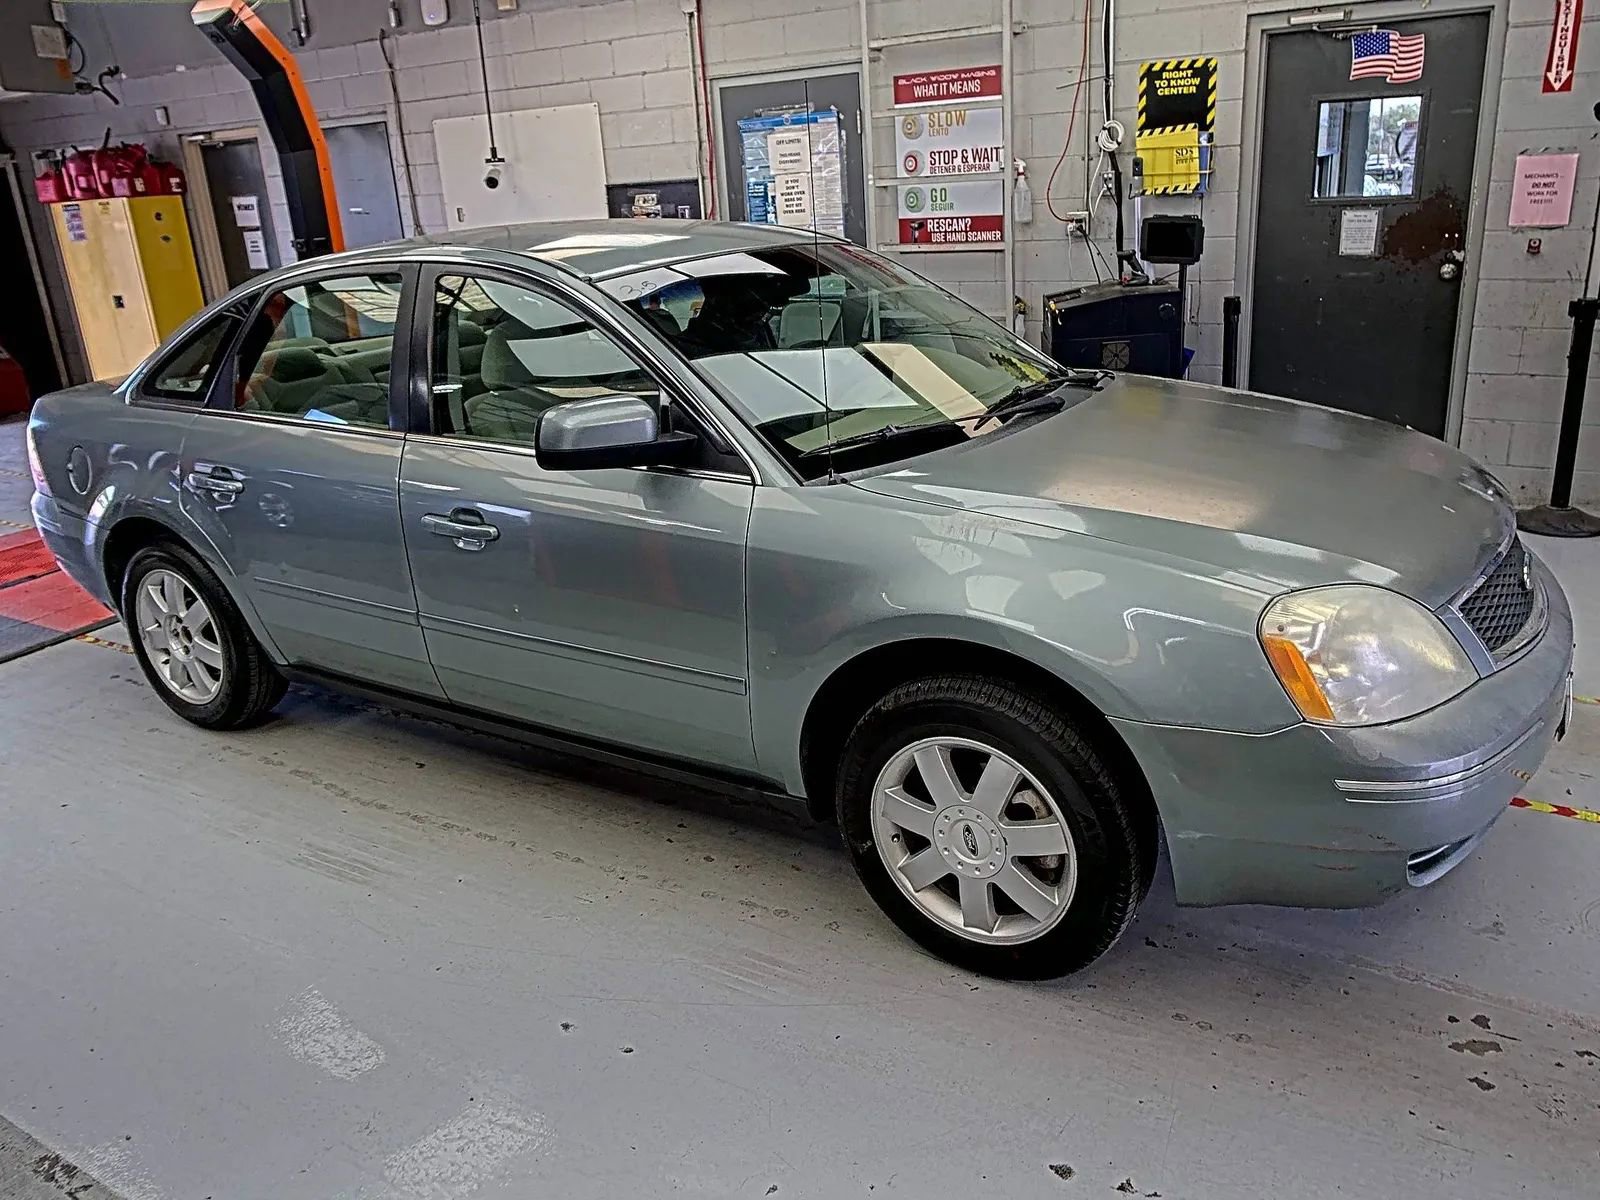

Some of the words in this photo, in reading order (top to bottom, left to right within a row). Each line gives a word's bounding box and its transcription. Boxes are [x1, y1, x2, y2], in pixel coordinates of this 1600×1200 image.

[1162, 70, 1193, 79] RIGHT
[1170, 78, 1200, 86] KNOW
[913, 83, 938, 97] WHAT
[939, 82, 947, 95] IT
[949, 79, 981, 94] MEANS
[1157, 86, 1196, 95] CENTER
[928, 110, 967, 128] SLOW
[928, 127, 949, 137] LENTO
[929, 149, 958, 166] STOP
[961, 148, 969, 163] &
[971, 147, 1000, 162] WAIT
[929, 165, 958, 174] DETENER
[958, 164, 962, 173] &
[963, 164, 991, 172] ESPERAR
[930, 187, 948, 203] GO
[930, 202, 954, 212] SEGUIR
[927, 218, 972, 233] RESCAN?
[931, 232, 946, 243] USE
[946, 231, 967, 241] HAND
[967, 230, 1002, 241] SCANNER
